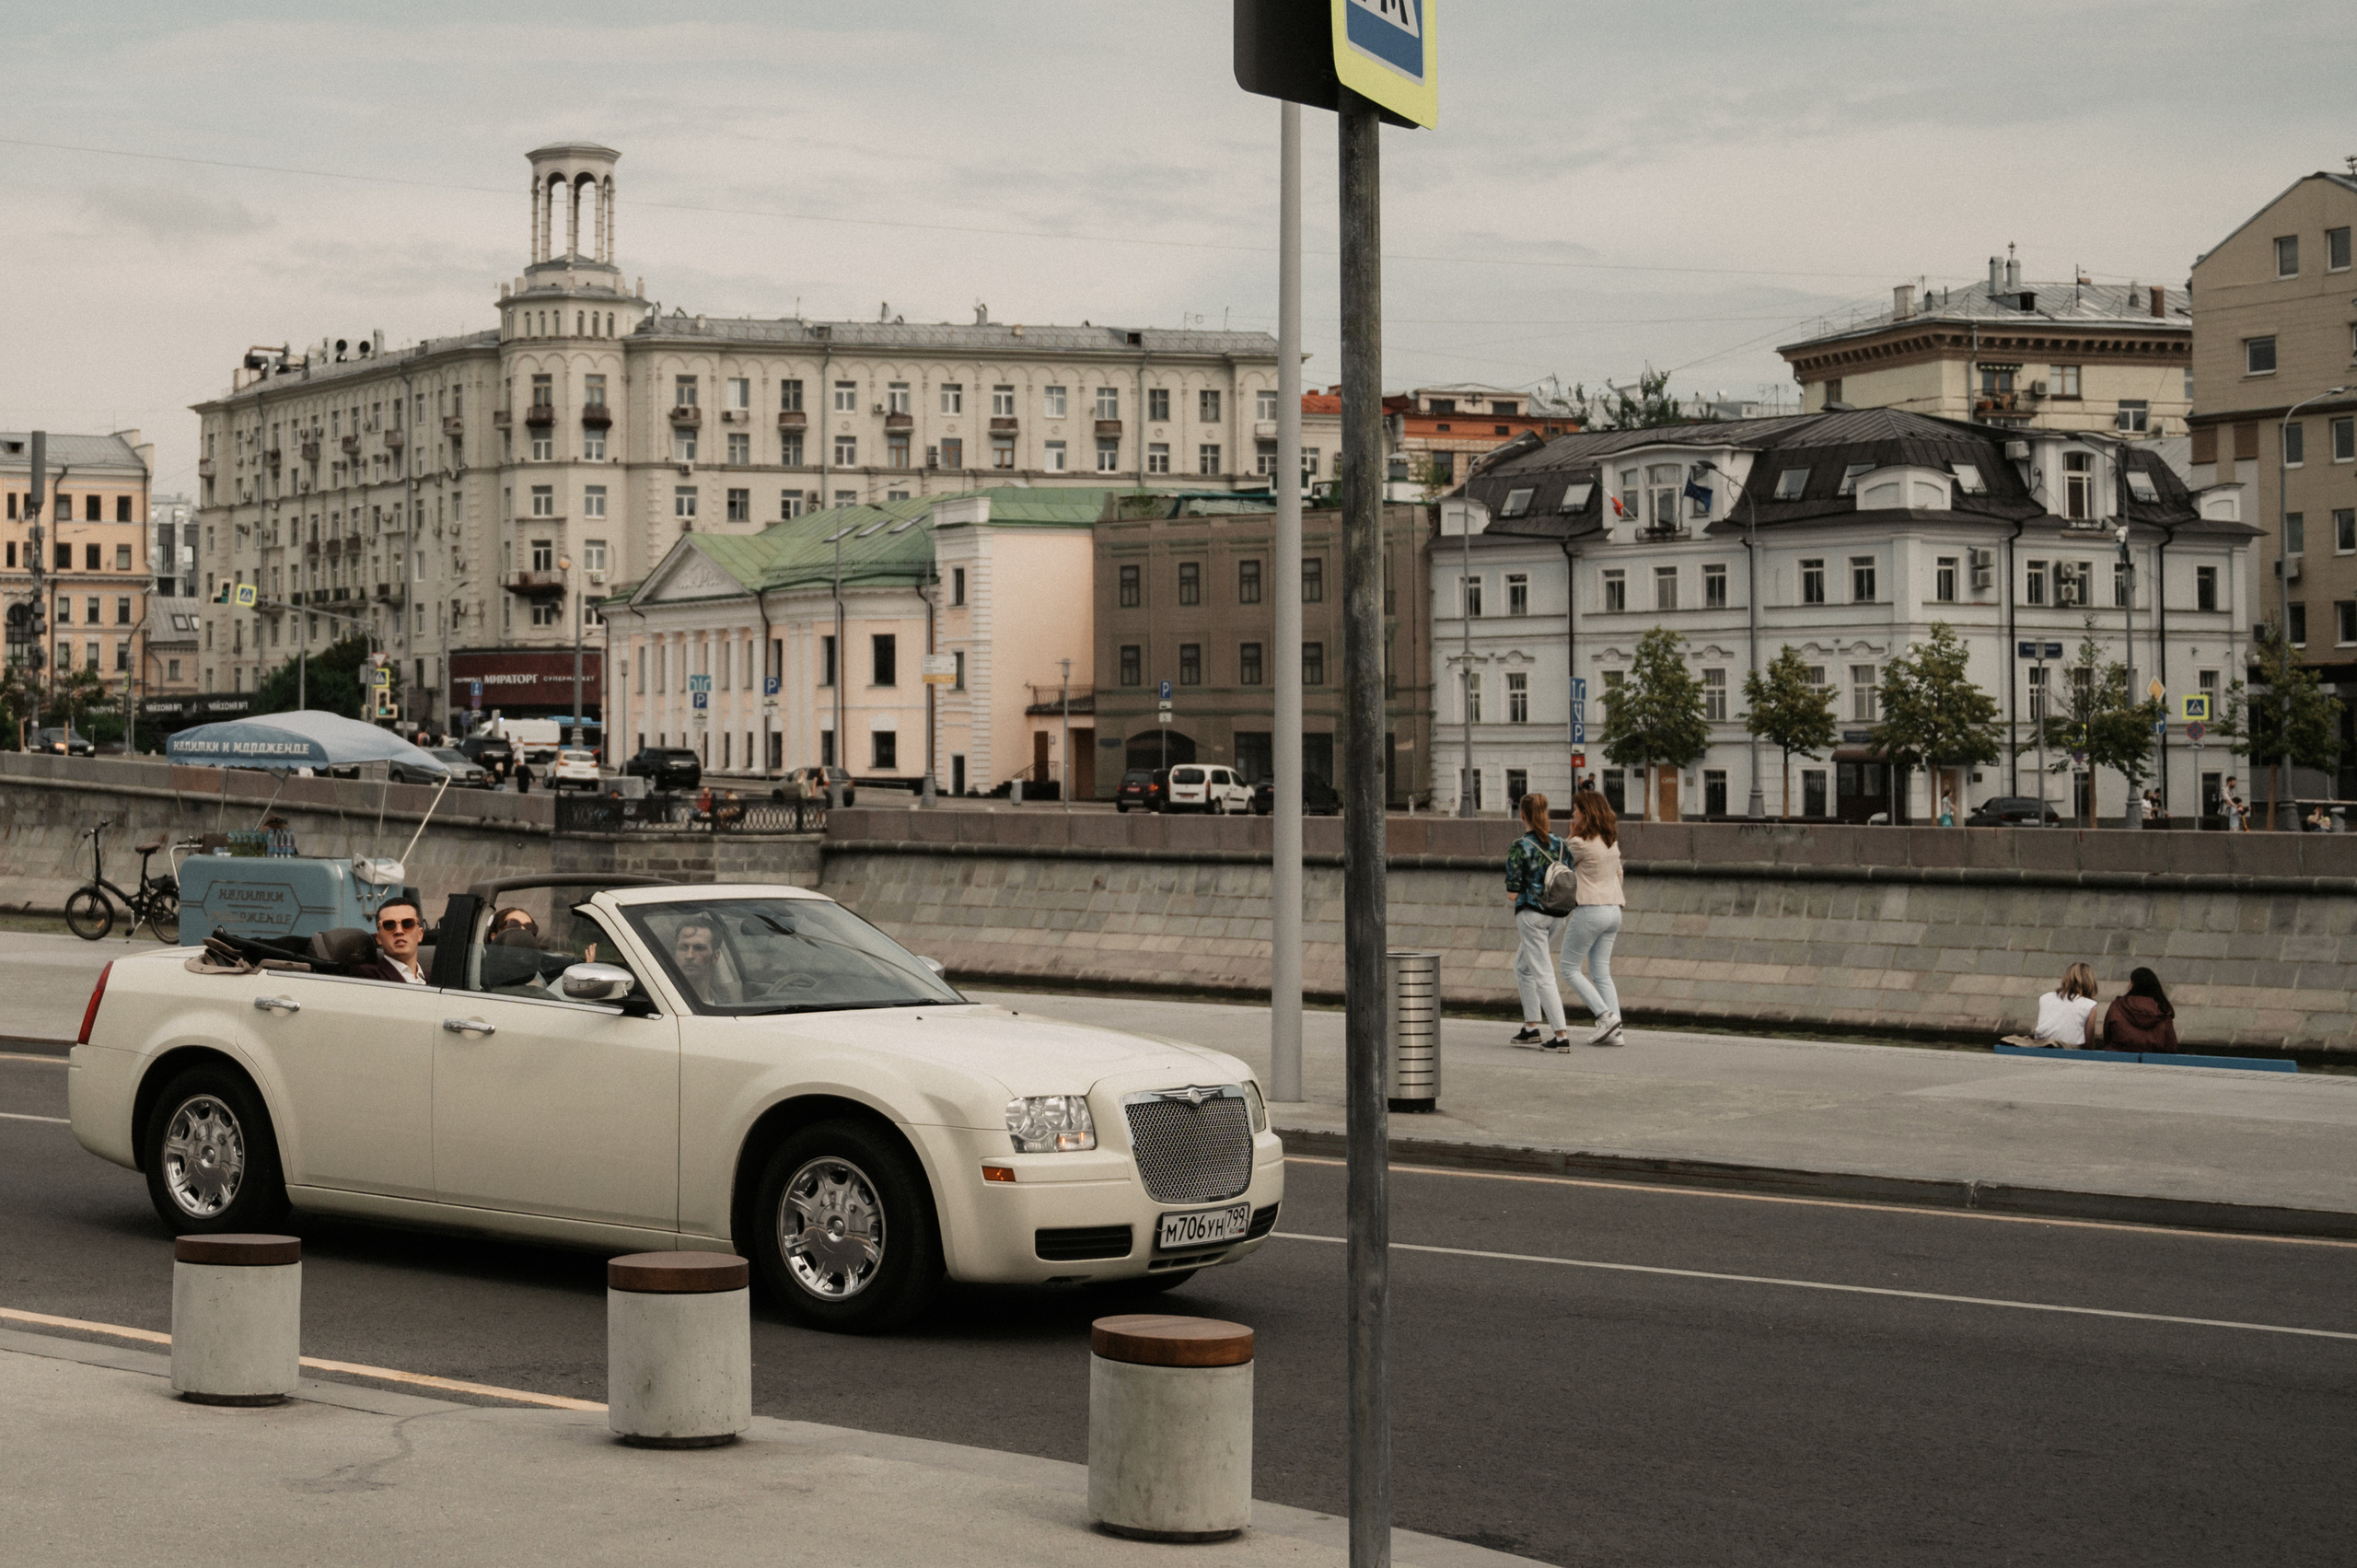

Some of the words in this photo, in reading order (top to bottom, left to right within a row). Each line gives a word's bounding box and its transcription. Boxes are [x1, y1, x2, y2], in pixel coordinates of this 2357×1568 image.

[484, 674, 538, 684] МИРАТОРГ
[768, 679, 777, 692] P
[1162, 682, 1169, 697] P
[696, 693, 705, 707] P
[1575, 725, 1583, 742] P
[222, 743, 229, 752] И
[1166, 1214, 1225, 1242] М706УН
[1226, 1207, 1246, 1228] 799
